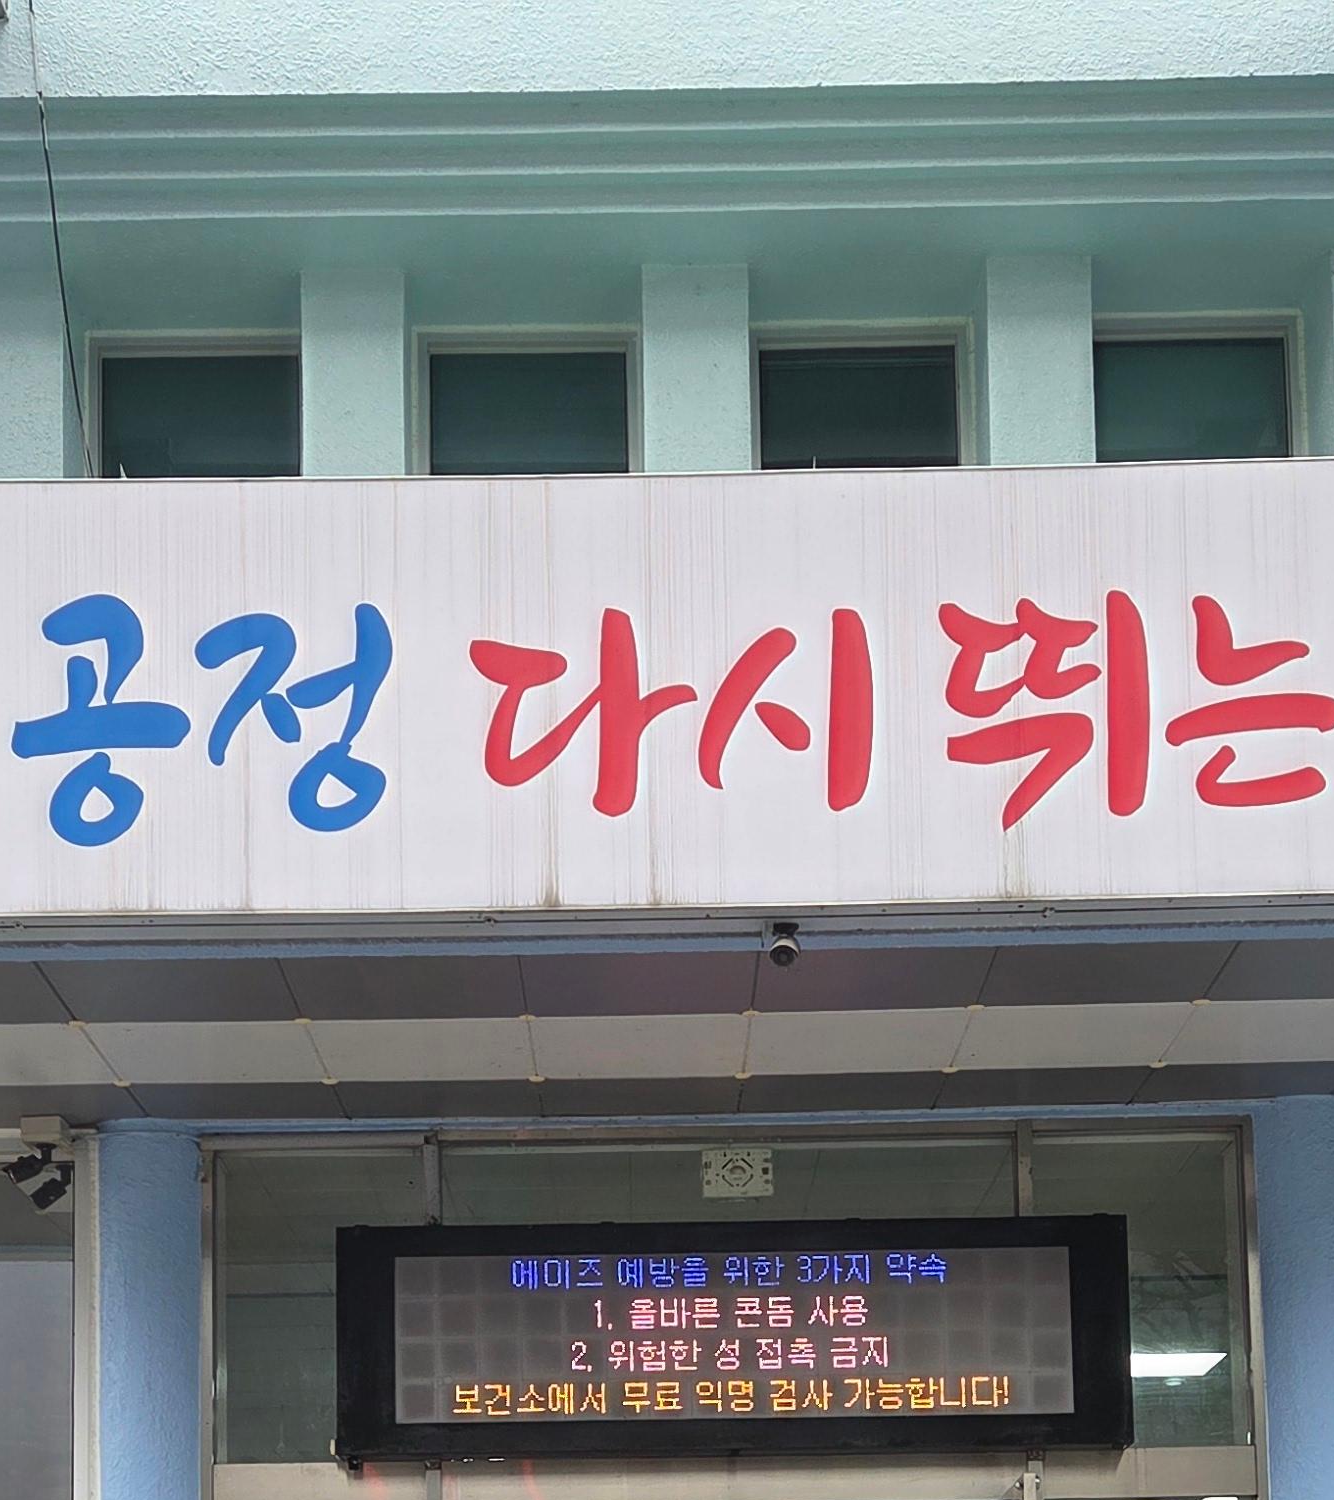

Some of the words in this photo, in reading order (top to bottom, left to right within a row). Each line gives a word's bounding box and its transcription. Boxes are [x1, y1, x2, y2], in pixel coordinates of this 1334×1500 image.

[12, 595, 392, 847] 공정
[470, 609, 872, 816] 다시
[510, 1258, 603, 1289] 에이즈
[616, 1256, 708, 1288] 예방을
[723, 1256, 782, 1287] 위한
[797, 1255, 871, 1285] 3가지
[885, 1253, 947, 1284] 약속
[594, 1300, 614, 1329] 1.
[629, 1299, 720, 1330] 올바른
[735, 1297, 795, 1329] 콘돔
[808, 1295, 868, 1328] 사용
[570, 1343, 593, 1372] 2.
[608, 1339, 701, 1372] 위험한
[714, 1338, 742, 1370] 성
[755, 1337, 816, 1369] 접촉
[831, 1335, 889, 1368] 금지
[452, 1383, 607, 1416] 보건소에서
[622, 1383, 683, 1413] 무료
[695, 1380, 754, 1413] 익명
[769, 1379, 832, 1412] 검사
[843, 1376, 1011, 1410] 가능합니다!
